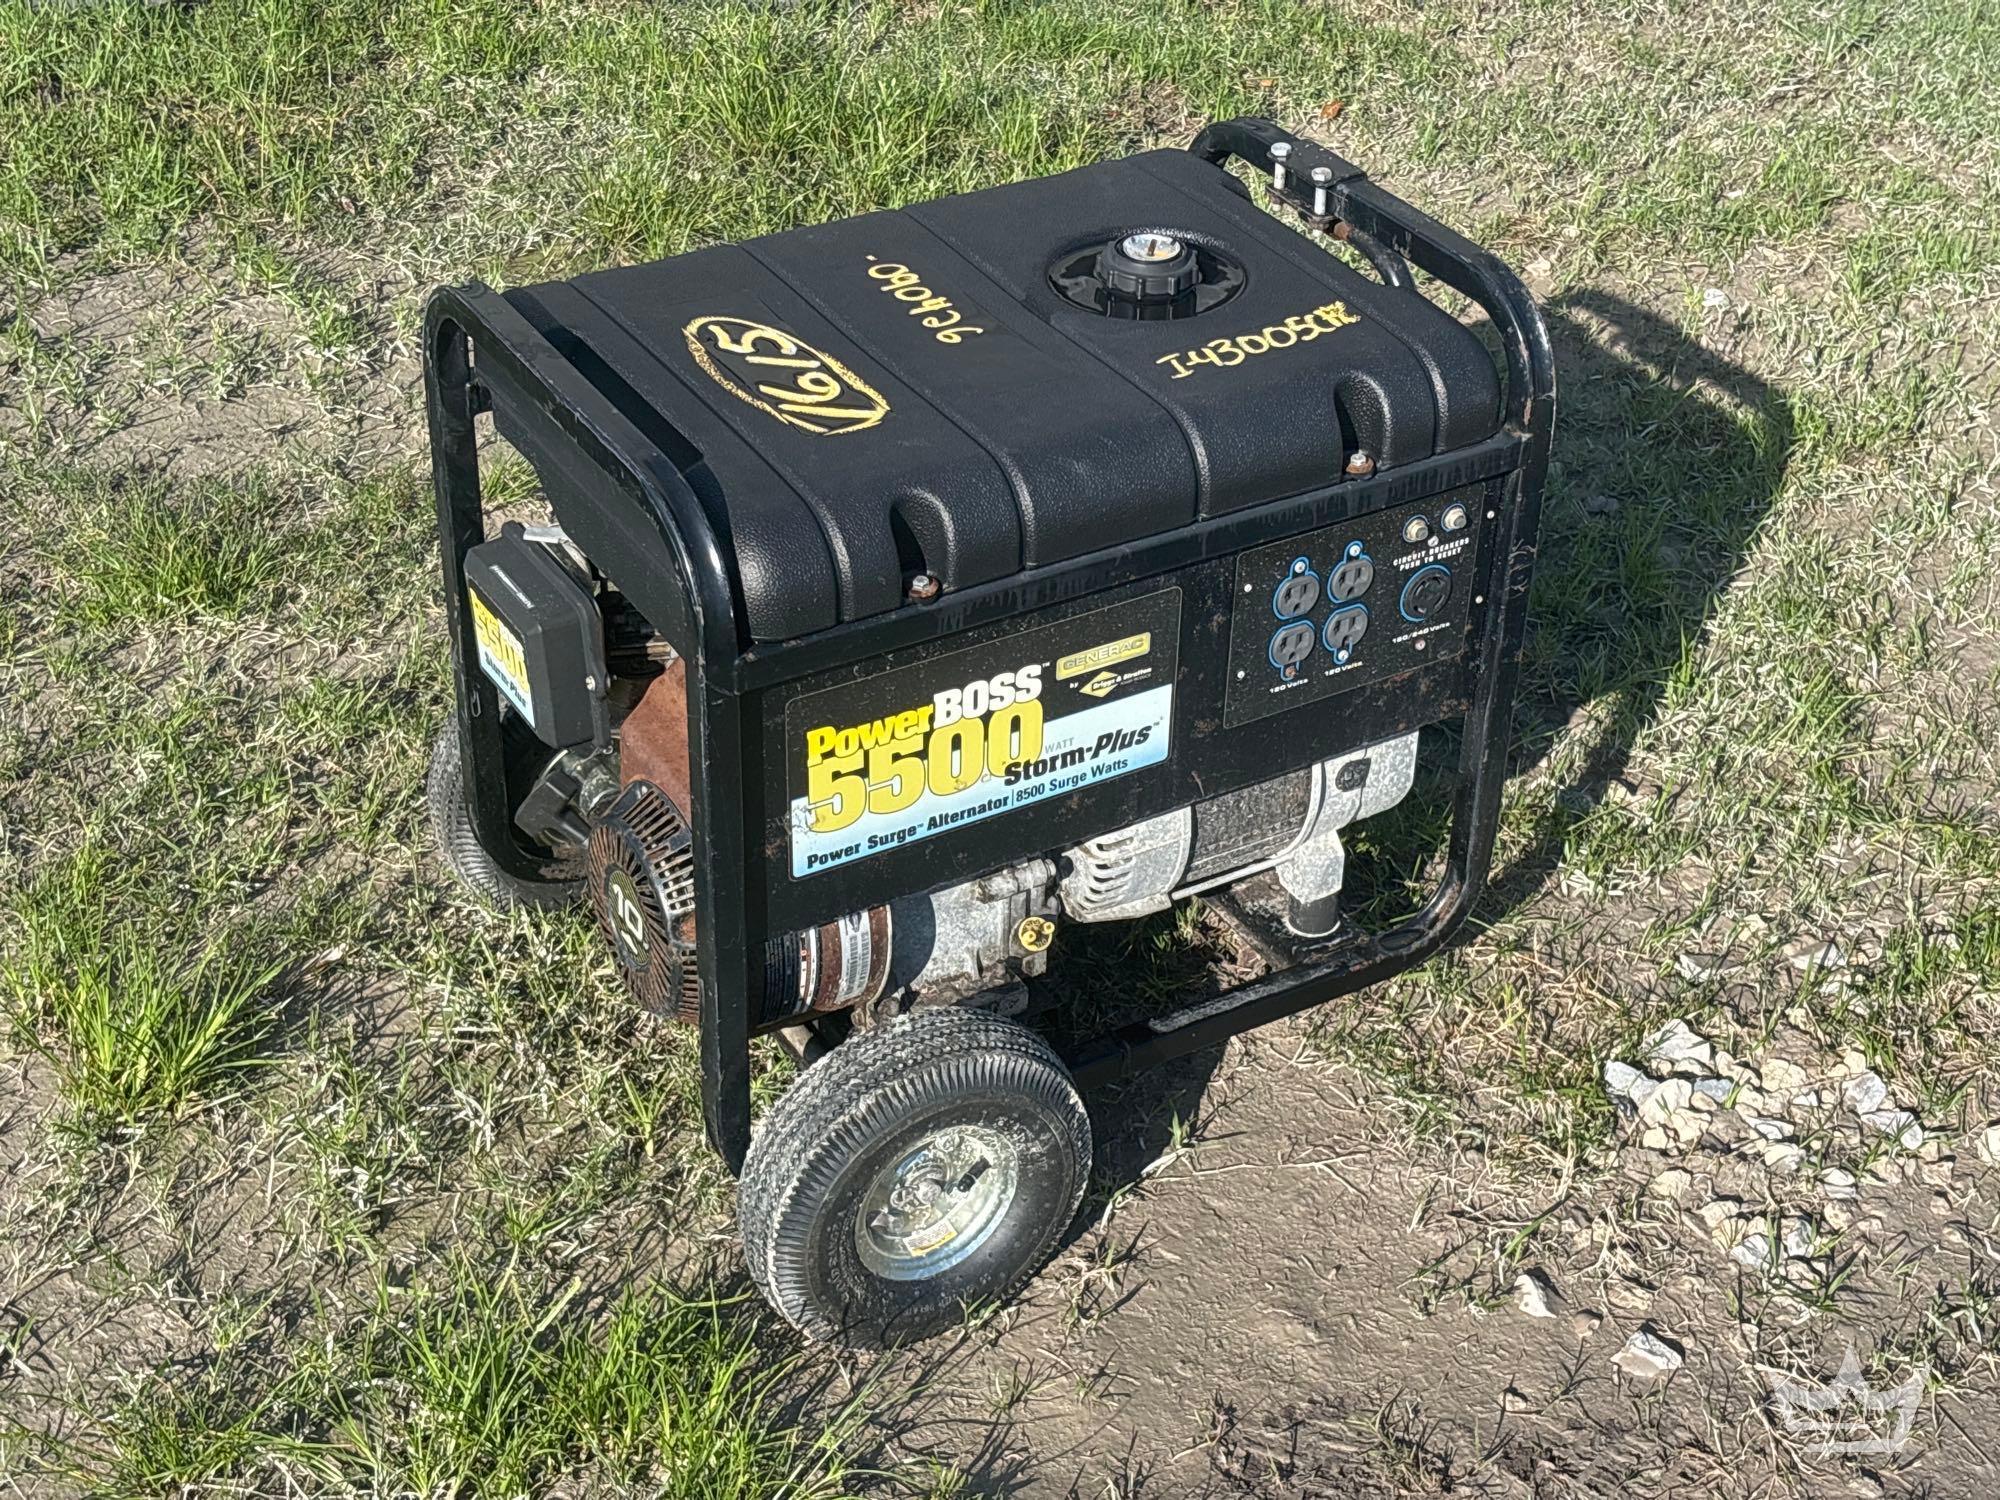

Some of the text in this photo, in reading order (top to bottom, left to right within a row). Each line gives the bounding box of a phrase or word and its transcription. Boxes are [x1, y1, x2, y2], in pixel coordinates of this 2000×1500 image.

[1393, 537, 1470, 566] CIRCUIT BREAKERS
[1400, 546, 1462, 572] PUSH TO RESET
[1063, 638, 1144, 670] GENERAC
[1324, 667, 1341, 676] 120
[1269, 684, 1286, 693] 120
[1045, 737, 1075, 754] WATT
[808, 698, 1044, 834] 5500
[807, 758, 1129, 869] Power Surge Alternator 8500 Surge Watts
